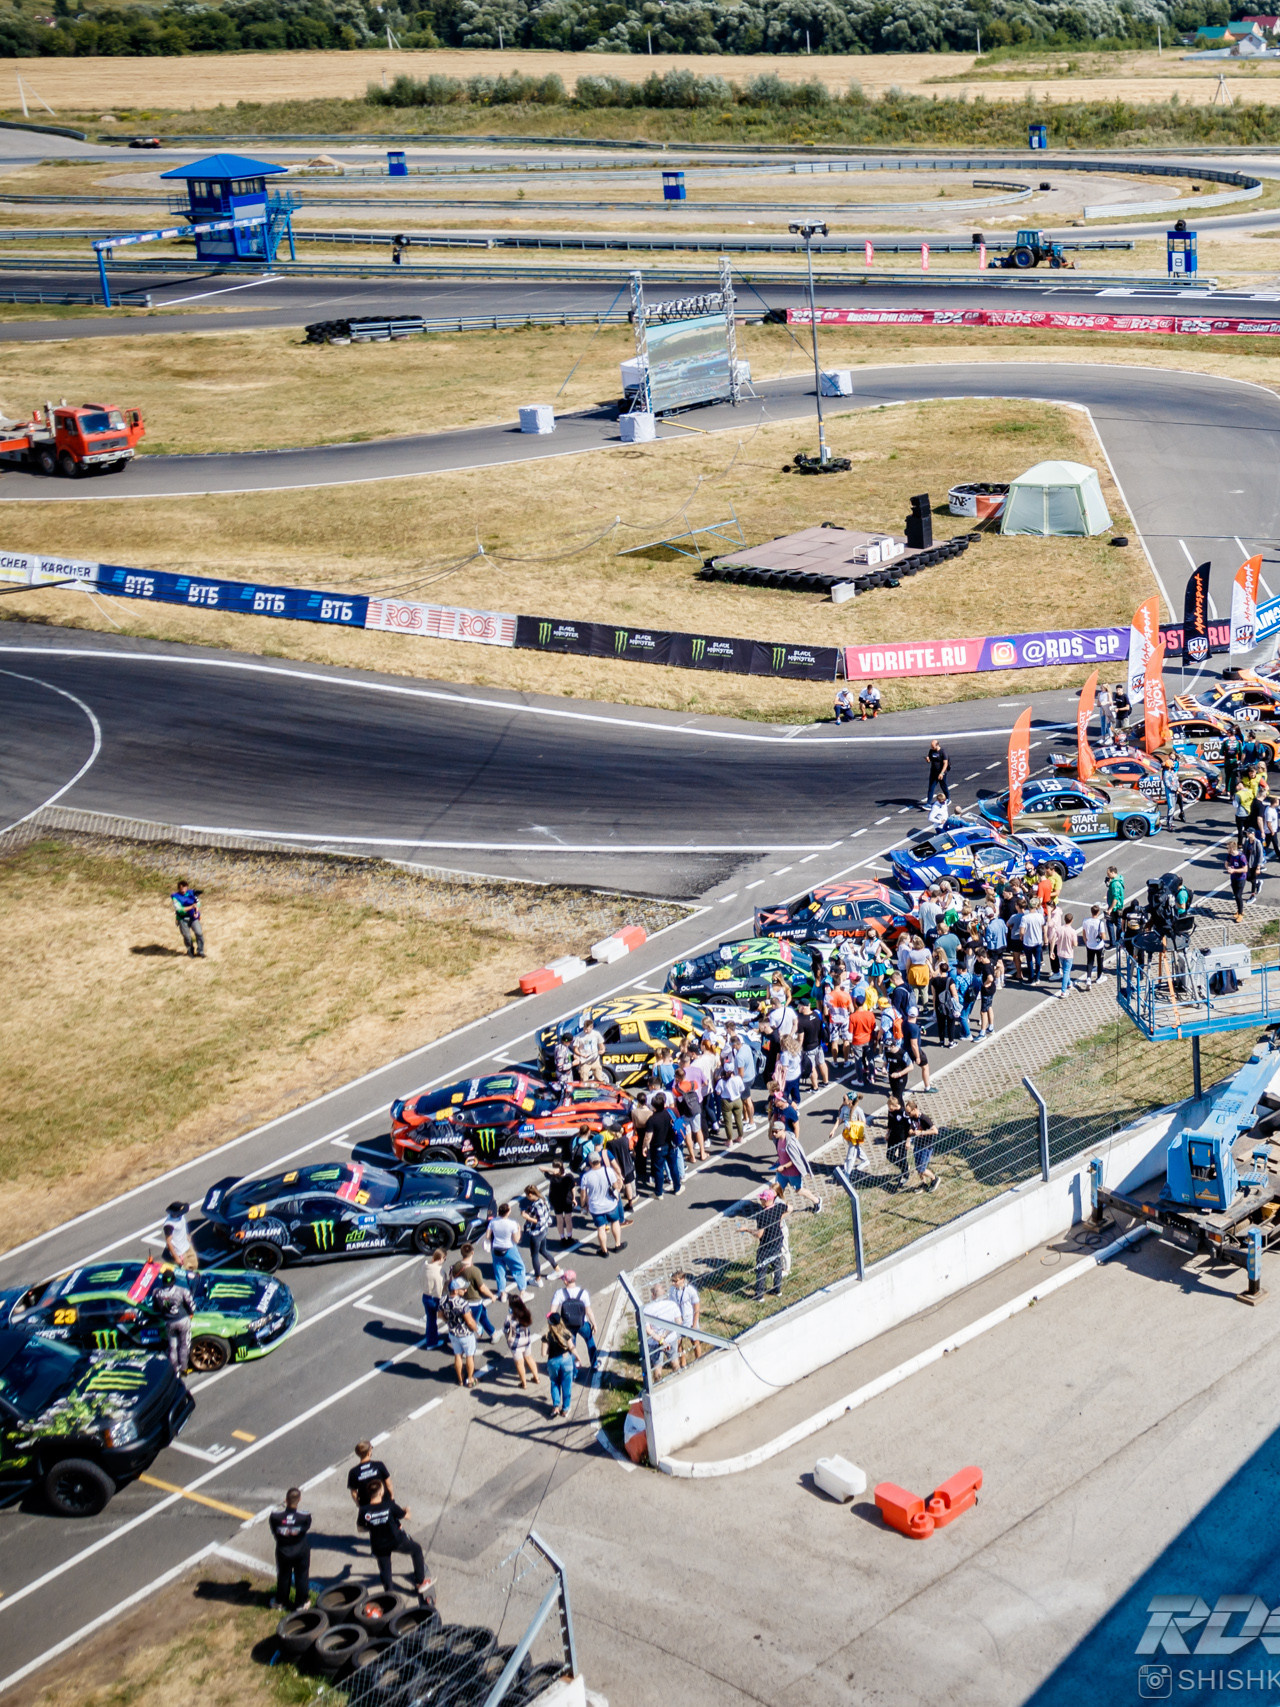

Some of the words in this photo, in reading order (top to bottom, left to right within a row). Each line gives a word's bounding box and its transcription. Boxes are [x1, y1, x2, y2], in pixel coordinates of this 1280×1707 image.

[790, 311, 823, 323] RDS
[823, 312, 839, 320] GP
[846, 313, 878, 322] Russian
[898, 313, 924, 323] Series
[932, 311, 965, 323] RDS
[1002, 313, 1032, 324] RDS
[1066, 315, 1095, 327] RDS
[1095, 316, 1109, 325] GP
[1129, 318, 1160, 330] RDS
[1159, 318, 1173, 328] GP
[1180, 320, 1213, 332] RDS
[1237, 322, 1270, 332] Russian
[124, 575, 155, 597] ВТБ
[188, 583, 219, 605] ВТБ
[253, 591, 286, 613] ВТБ
[1194, 573, 1206, 634] Motorsport
[320, 599, 353, 621] ВТБ
[1022, 635, 1120, 663] @RDS_GP
[858, 646, 967, 673] VDRIFTE.RU
[1018, 749, 1026, 781] VOLT
[1138, 780, 1161, 790] START
[1071, 814, 1099, 825] START
[1072, 823, 1099, 834] VOLT
[603, 1053, 648, 1065] DRIVE
[429, 1136, 463, 1146] SAILUN
[498, 1142, 550, 1157] ДАРКСАЙД
[248, 1203, 267, 1219] 37
[245, 1227, 282, 1239] SAILUN
[54, 1308, 77, 1325] 23
